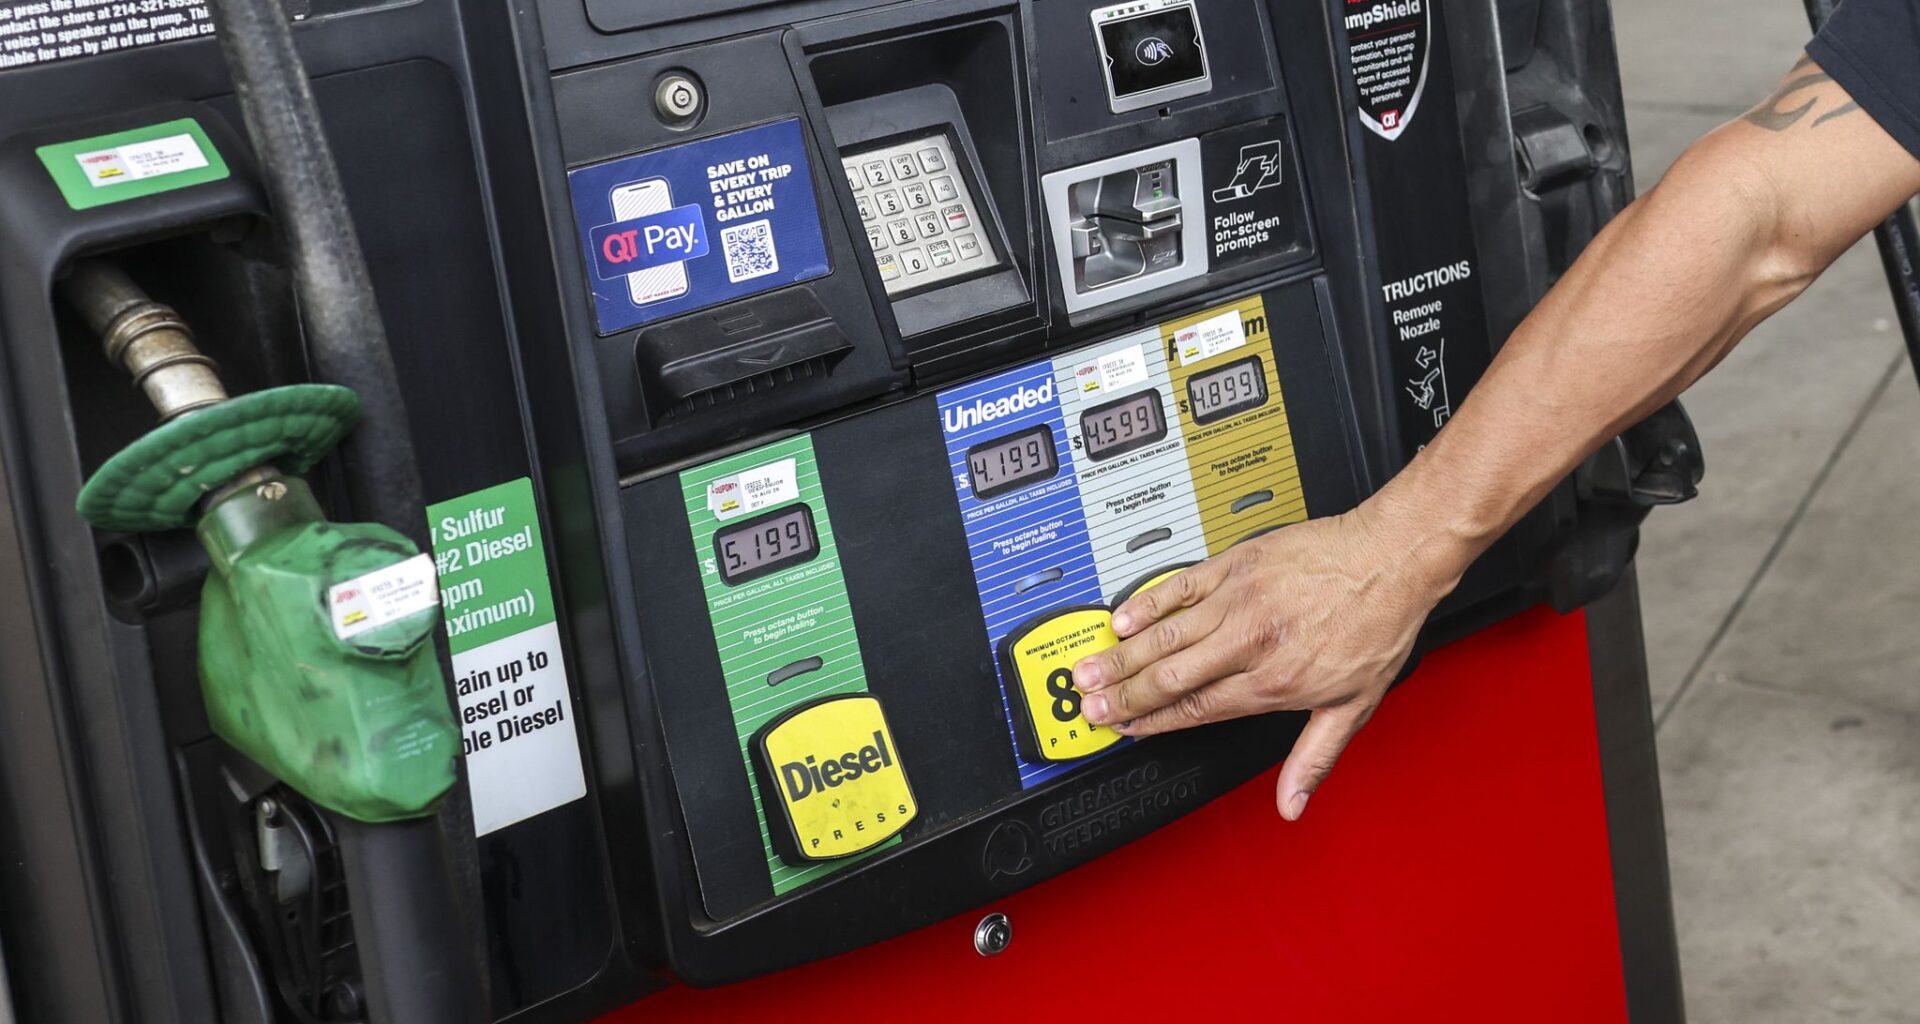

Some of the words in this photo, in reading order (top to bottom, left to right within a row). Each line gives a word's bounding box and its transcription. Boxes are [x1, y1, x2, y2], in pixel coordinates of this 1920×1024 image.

[14, 3, 50, 20] press
[39, 15, 61, 29] the
[62, 12, 95, 26] store
[97, 6, 112, 20] at
[4, 35, 41, 51] voice
[41, 32, 57, 44] to
[58, 24, 108, 43] speaker
[110, 22, 126, 34] on
[127, 17, 149, 30] the
[150, 13, 187, 29] pump.
[38, 47, 57, 61] for
[59, 44, 82, 58] use
[83, 39, 99, 55] by
[101, 36, 119, 51] all
[120, 34, 134, 47] of
[135, 32, 156, 45] our
[158, 23, 198, 41] valued
[1350, 41, 1374, 54] protect
[1374, 38, 1388, 48] your
[1389, 29, 1416, 45] personal
[1358, 59, 1389, 73] monitored
[1390, 55, 1402, 66] and
[1403, 52, 1413, 62] will
[1384, 47, 1396, 56] this
[1397, 43, 1415, 54] pump
[1357, 75, 1375, 85] alarm
[1376, 71, 1380, 80] if
[1381, 64, 1411, 79] accessed
[1361, 87, 1369, 96] by
[1370, 75, 1410, 93] unauthorized
[1371, 88, 1403, 106] personnel.
[1383, 112, 1396, 127] QT
[706, 159, 745, 179] SAVE
[747, 154, 770, 170] ON
[710, 170, 756, 194] EVERY
[761, 164, 792, 183] TRIP
[875, 171, 884, 182] 2
[902, 165, 911, 175] 3
[714, 195, 725, 208] &
[727, 183, 774, 205] EVERY
[848, 178, 854, 187] 1
[908, 185, 922, 193] MNO
[716, 198, 775, 222] GALLON
[860, 207, 868, 217] 4
[887, 201, 895, 211] 5
[915, 194, 923, 204] 6
[920, 214, 935, 222] WXYZ
[927, 223, 935, 233] 9
[1214, 211, 1254, 230] Follow
[1215, 216, 1280, 242] on-screen
[603, 229, 639, 265] QT
[871, 236, 878, 247] 7
[900, 230, 908, 240] 8
[929, 240, 948, 251] ENTER
[961, 241, 976, 250] HELP
[1216, 231, 1269, 257] prompts
[912, 259, 920, 269] 0
[1382, 260, 1471, 303] TRUCTIONS
[1393, 300, 1442, 325] Remove
[1400, 317, 1441, 341] Nozzle
[944, 377, 1052, 433] Unleaded
[1181, 400, 1188, 413] $
[1193, 371, 1252, 410] 4.899
[1073, 435, 1082, 450] $
[1087, 405, 1149, 446] 4.599
[959, 473, 968, 489] $
[974, 440, 1040, 483] 4.199
[1081, 471, 1096, 479] PRICE
[1140, 450, 1155, 459] TAXES
[1156, 442, 1180, 453] INCLUDED
[1211, 461, 1229, 471] Press
[1230, 453, 1251, 464] octane
[1252, 445, 1273, 456] button
[967, 511, 983, 520] PRICE
[1019, 494, 1029, 502] ALL
[1029, 488, 1046, 498] TAXES
[1047, 479, 1073, 493] INCLUDED
[1106, 499, 1125, 509] Press
[1126, 489, 1148, 502] octane
[1150, 481, 1171, 493] button
[1123, 500, 1141, 511] begin
[441, 506, 506, 541] Sulfur
[993, 539, 1014, 550] Press
[1014, 529, 1038, 542] octane
[1040, 520, 1063, 532] button
[435, 548, 462, 576] #2
[465, 525, 533, 566] Diesel
[705, 558, 716, 574] $
[725, 520, 802, 570] 5.199
[1002, 547, 1010, 555] to
[1011, 539, 1031, 552] begin
[713, 597, 732, 608] PRICE
[733, 593, 745, 601] PER
[773, 579, 784, 587] ALL
[785, 572, 805, 583] TAXES
[805, 562, 836, 576] INCLUDED
[743, 626, 766, 640] Press
[767, 615, 795, 629] octane
[796, 606, 824, 620] button
[753, 637, 762, 645] to
[764, 628, 787, 642] begin
[787, 618, 817, 633] fueling.
[1025, 640, 1055, 656] MINIMUM
[1056, 632, 1081, 645] OCTANE
[1082, 622, 1105, 635] RATING
[1040, 649, 1059, 661] (R+M)
[1070, 634, 1096, 649] METHOD
[457, 670, 492, 696] ain
[496, 659, 523, 683] up
[527, 651, 548, 672] to
[462, 690, 508, 724] esel
[513, 684, 535, 706] or
[1046, 667, 1082, 722] 8
[497, 699, 564, 743] Diesel
[1051, 722, 1097, 748] PRE
[780, 729, 893, 803] Diesel
[1040, 761, 1160, 828] GILBARCO
[1043, 771, 1202, 854] VEEDER-ROOT
